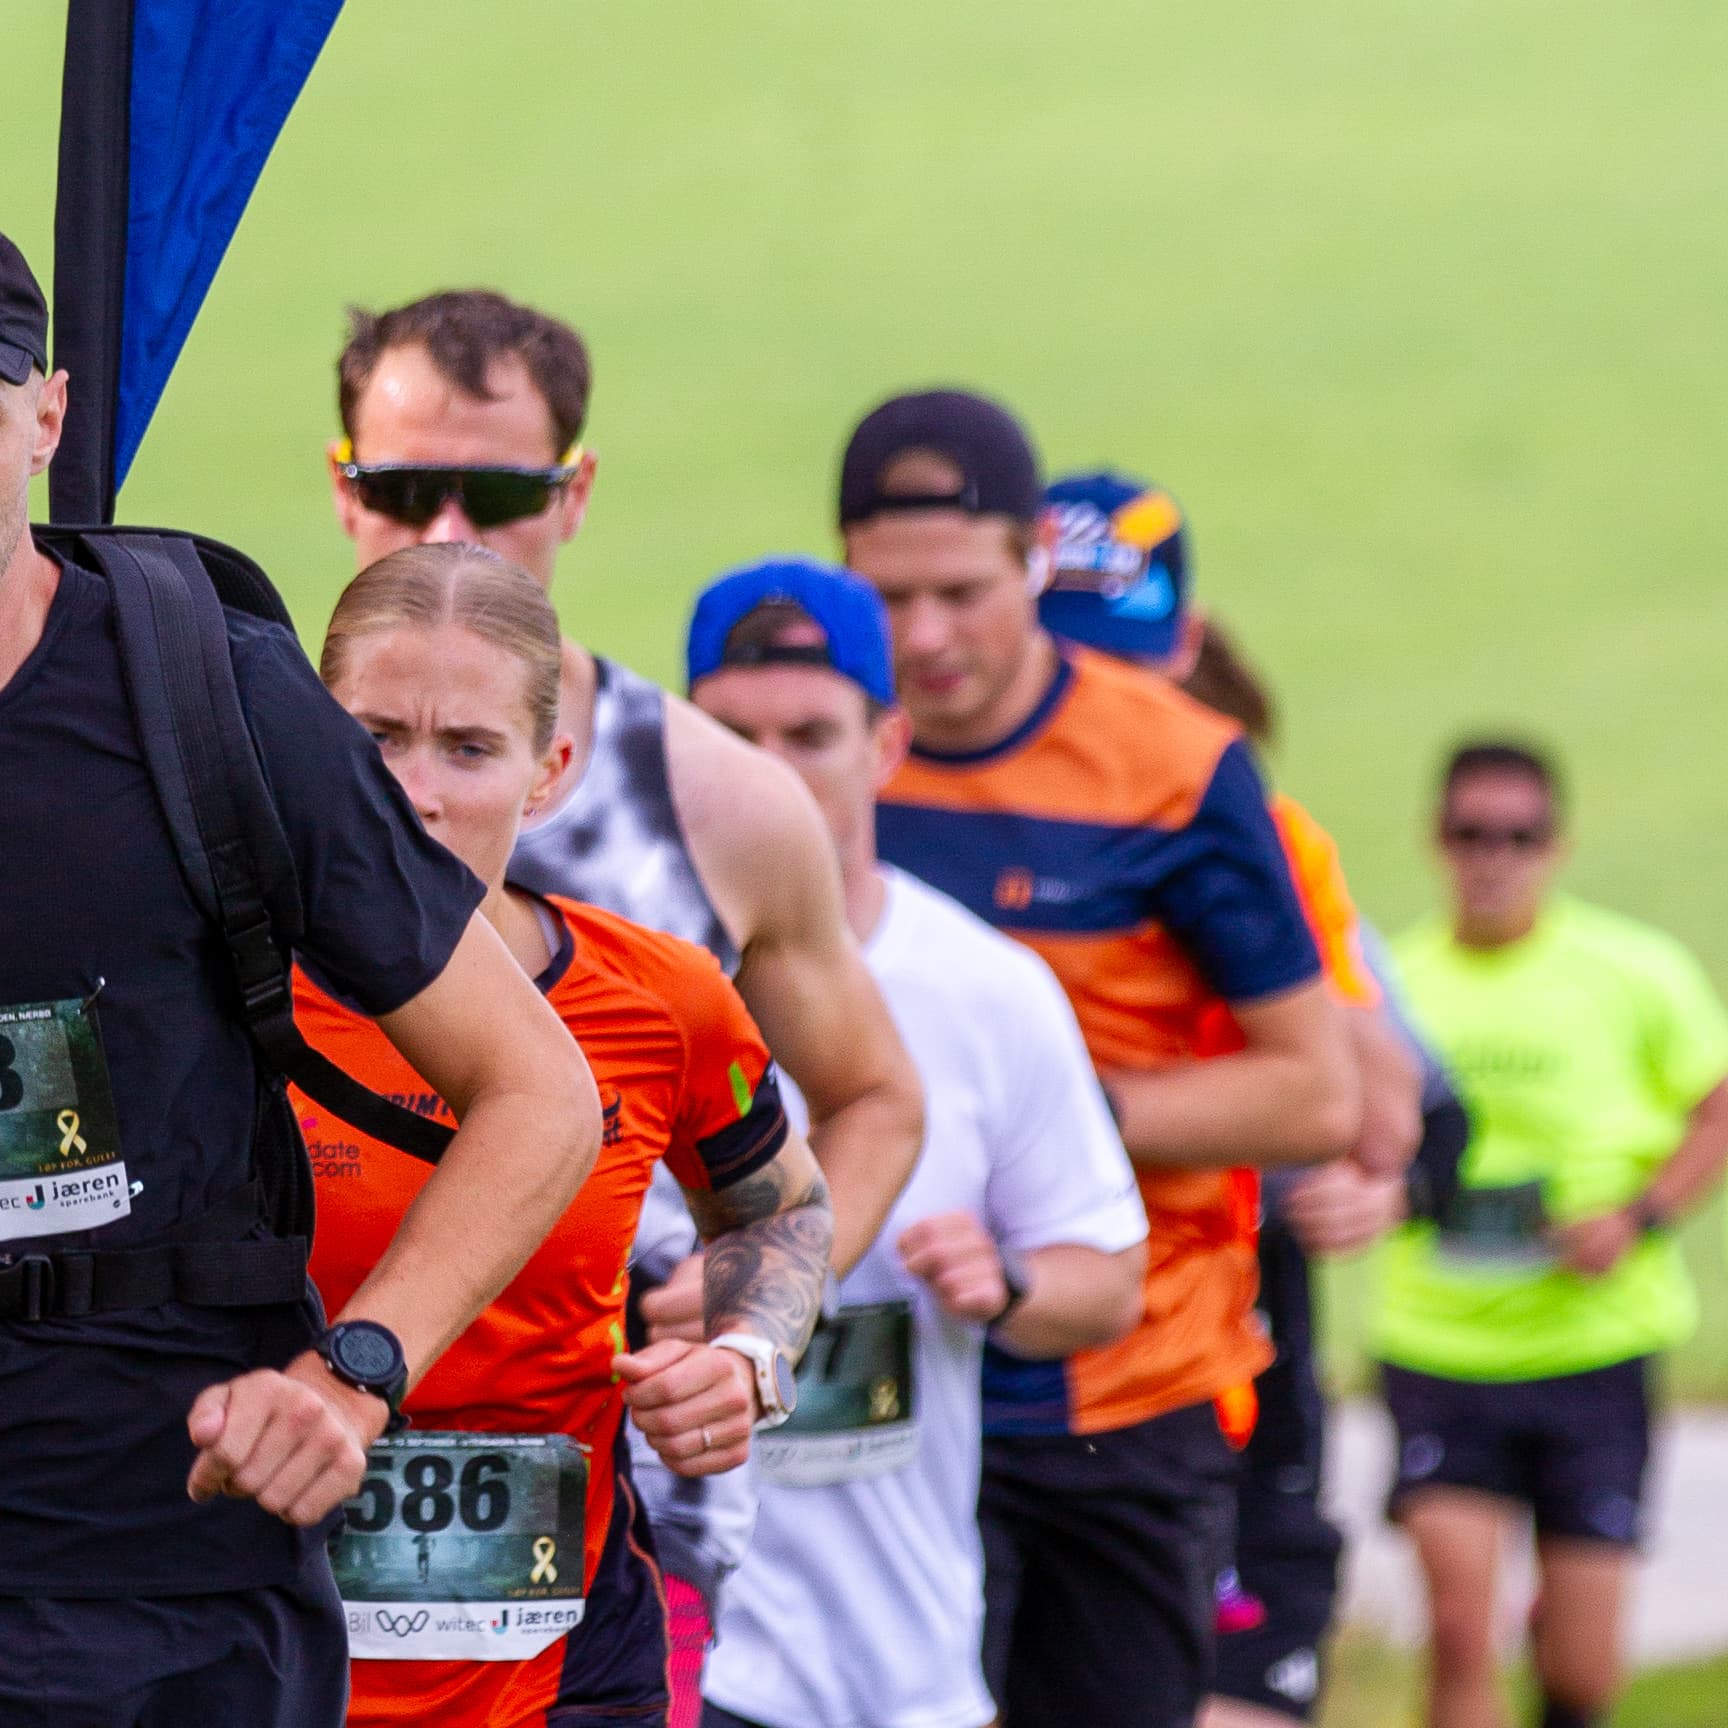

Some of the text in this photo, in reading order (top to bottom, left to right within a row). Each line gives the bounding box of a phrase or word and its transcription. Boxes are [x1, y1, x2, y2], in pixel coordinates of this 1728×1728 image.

[52, 1173, 119, 1201] jæren
[346, 1454, 511, 1533] 586
[436, 1617, 486, 1633] witec
[516, 1607, 578, 1627] jæren
